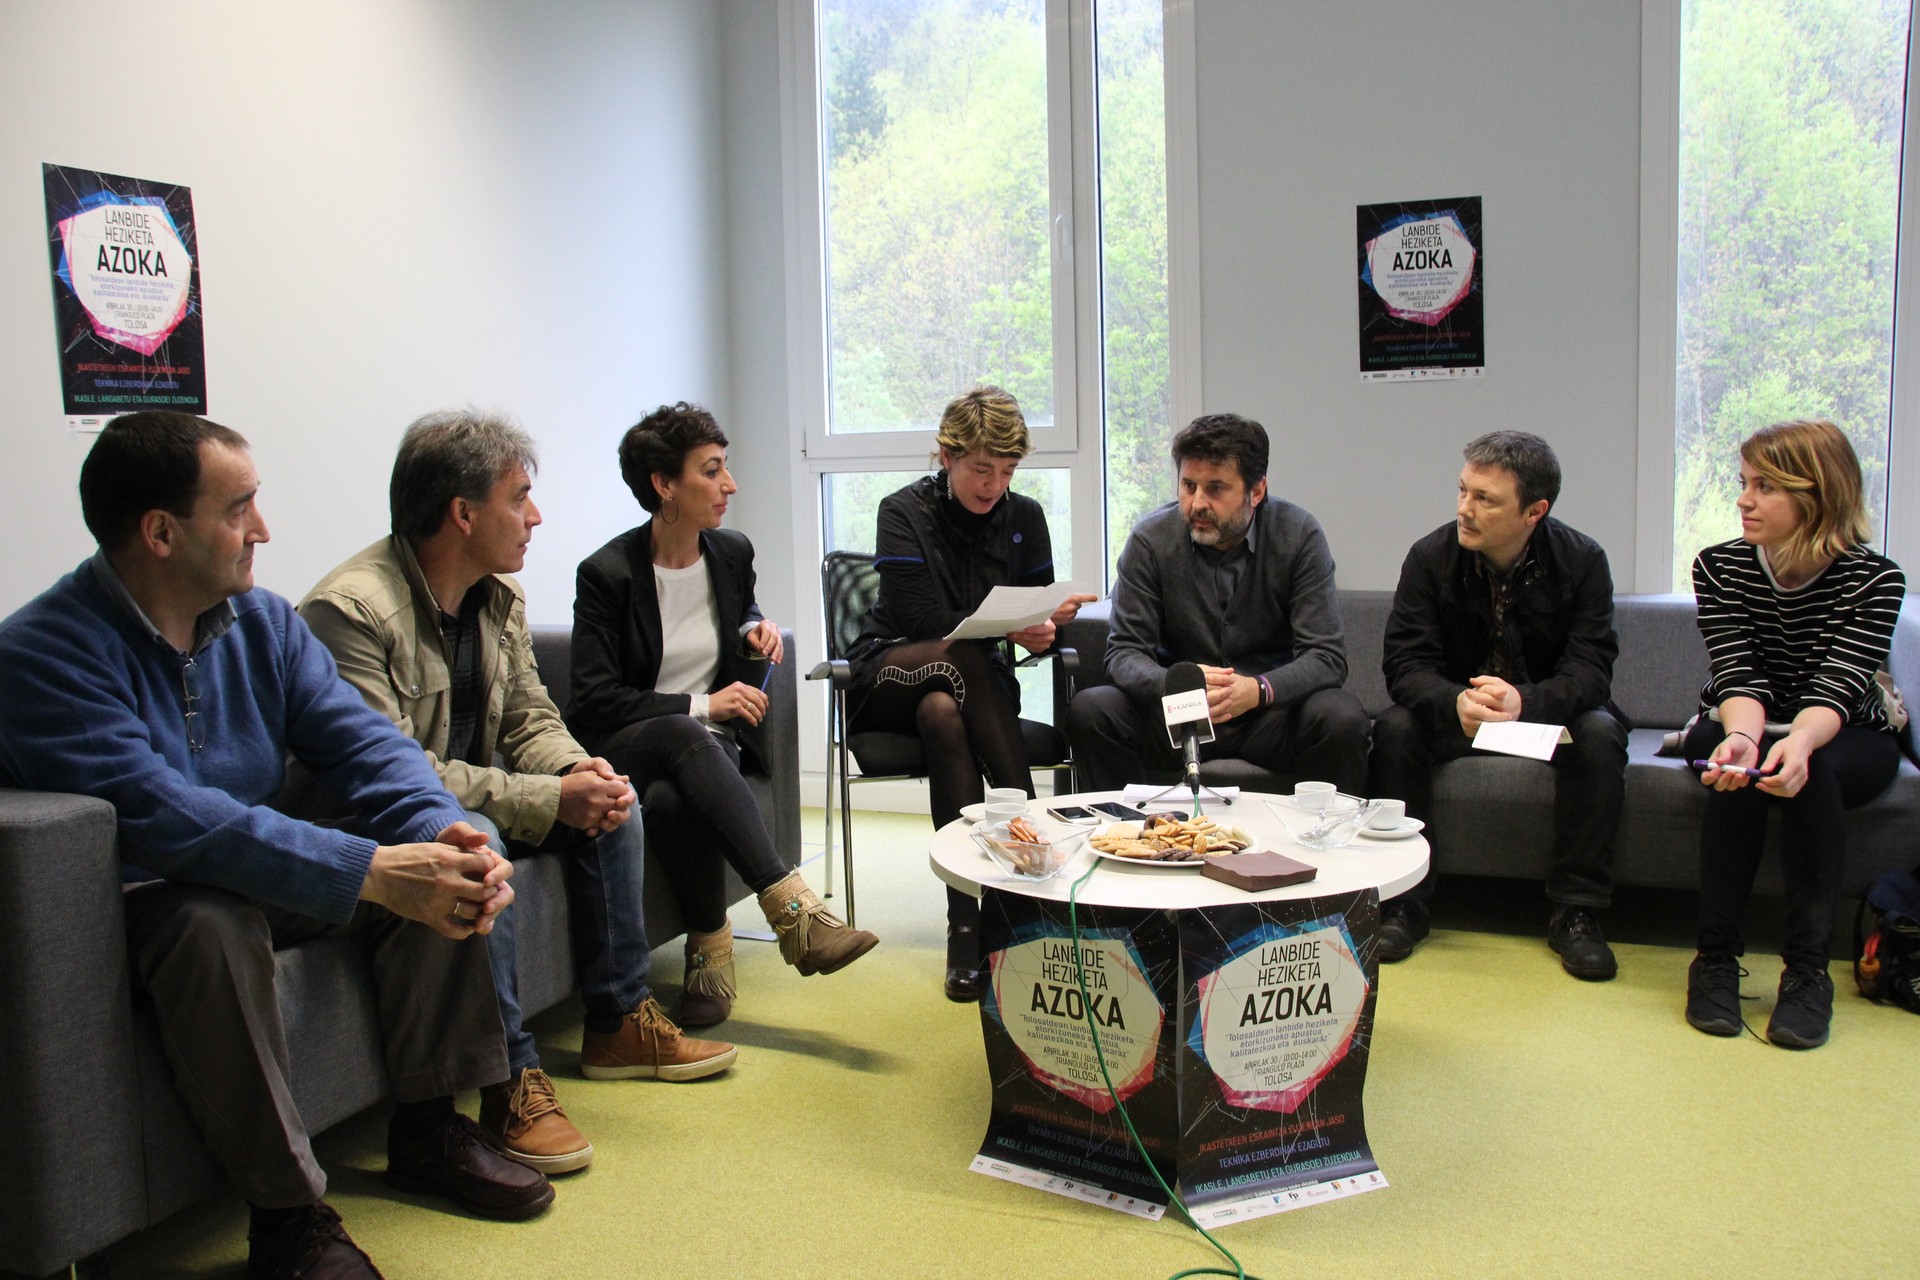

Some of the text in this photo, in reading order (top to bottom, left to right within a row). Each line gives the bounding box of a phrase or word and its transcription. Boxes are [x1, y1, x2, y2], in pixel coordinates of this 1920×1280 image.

[105, 209, 150, 229] LANBIDE
[105, 226, 154, 246] HEZIKETA
[1402, 224, 1440, 237] LANBIDE
[1401, 236, 1443, 249] HEZIKETA
[97, 244, 168, 278] AZOKA
[1392, 249, 1453, 271] AZOKA
[124, 320, 147, 329] TOLOSA
[1261, 941, 1321, 966] LANBIDE
[1042, 962, 1108, 990] HEZIKETA
[1257, 962, 1321, 987] HEZIKETA
[1031, 983, 1126, 1030] AZOKA
[1239, 982, 1332, 1027] AZOKA
[1035, 1025, 1086, 1041] etorkizuneko
[1275, 1023, 1304, 1035] lanbide
[1027, 1030, 1074, 1045] kalitatezkoa
[1075, 1041, 1087, 1049] eta
[1240, 1033, 1289, 1048] etorkizuneko
[1071, 1050, 1079, 1060] 30
[1230, 1043, 1276, 1058] kalitatezkoa
[1277, 1041, 1289, 1049] eta
[1056, 1056, 1088, 1070] TRIANGULO
[1244, 1058, 1269, 1070] APIRILAK
[1270, 1056, 1278, 1066] 30
[1283, 1050, 1317, 1062] 10:00-14:00
[1254, 1060, 1305, 1076] TRIANGULO PLAZA
[1068, 1068, 1099, 1083] TOLOSA
[1264, 1071, 1293, 1086] TOLOSA
[1027, 1124, 1057, 1141] TEKNIKA
[1200, 1114, 1345, 1153] IKASTETXEEN ESKAINTZA ZUZENEAN JASO
[1024, 1144, 1067, 1163] LANGABETU
[1068, 1155, 1081, 1167] ETA
[1082, 1160, 1121, 1177] GURASOEI
[1219, 1136, 1330, 1168] TEKNIKA EZBERDINAK EZAGUTU
[1195, 1150, 1362, 1194] IKASLE, LANGABETU ETA GURASOEI ZUZENDUA
